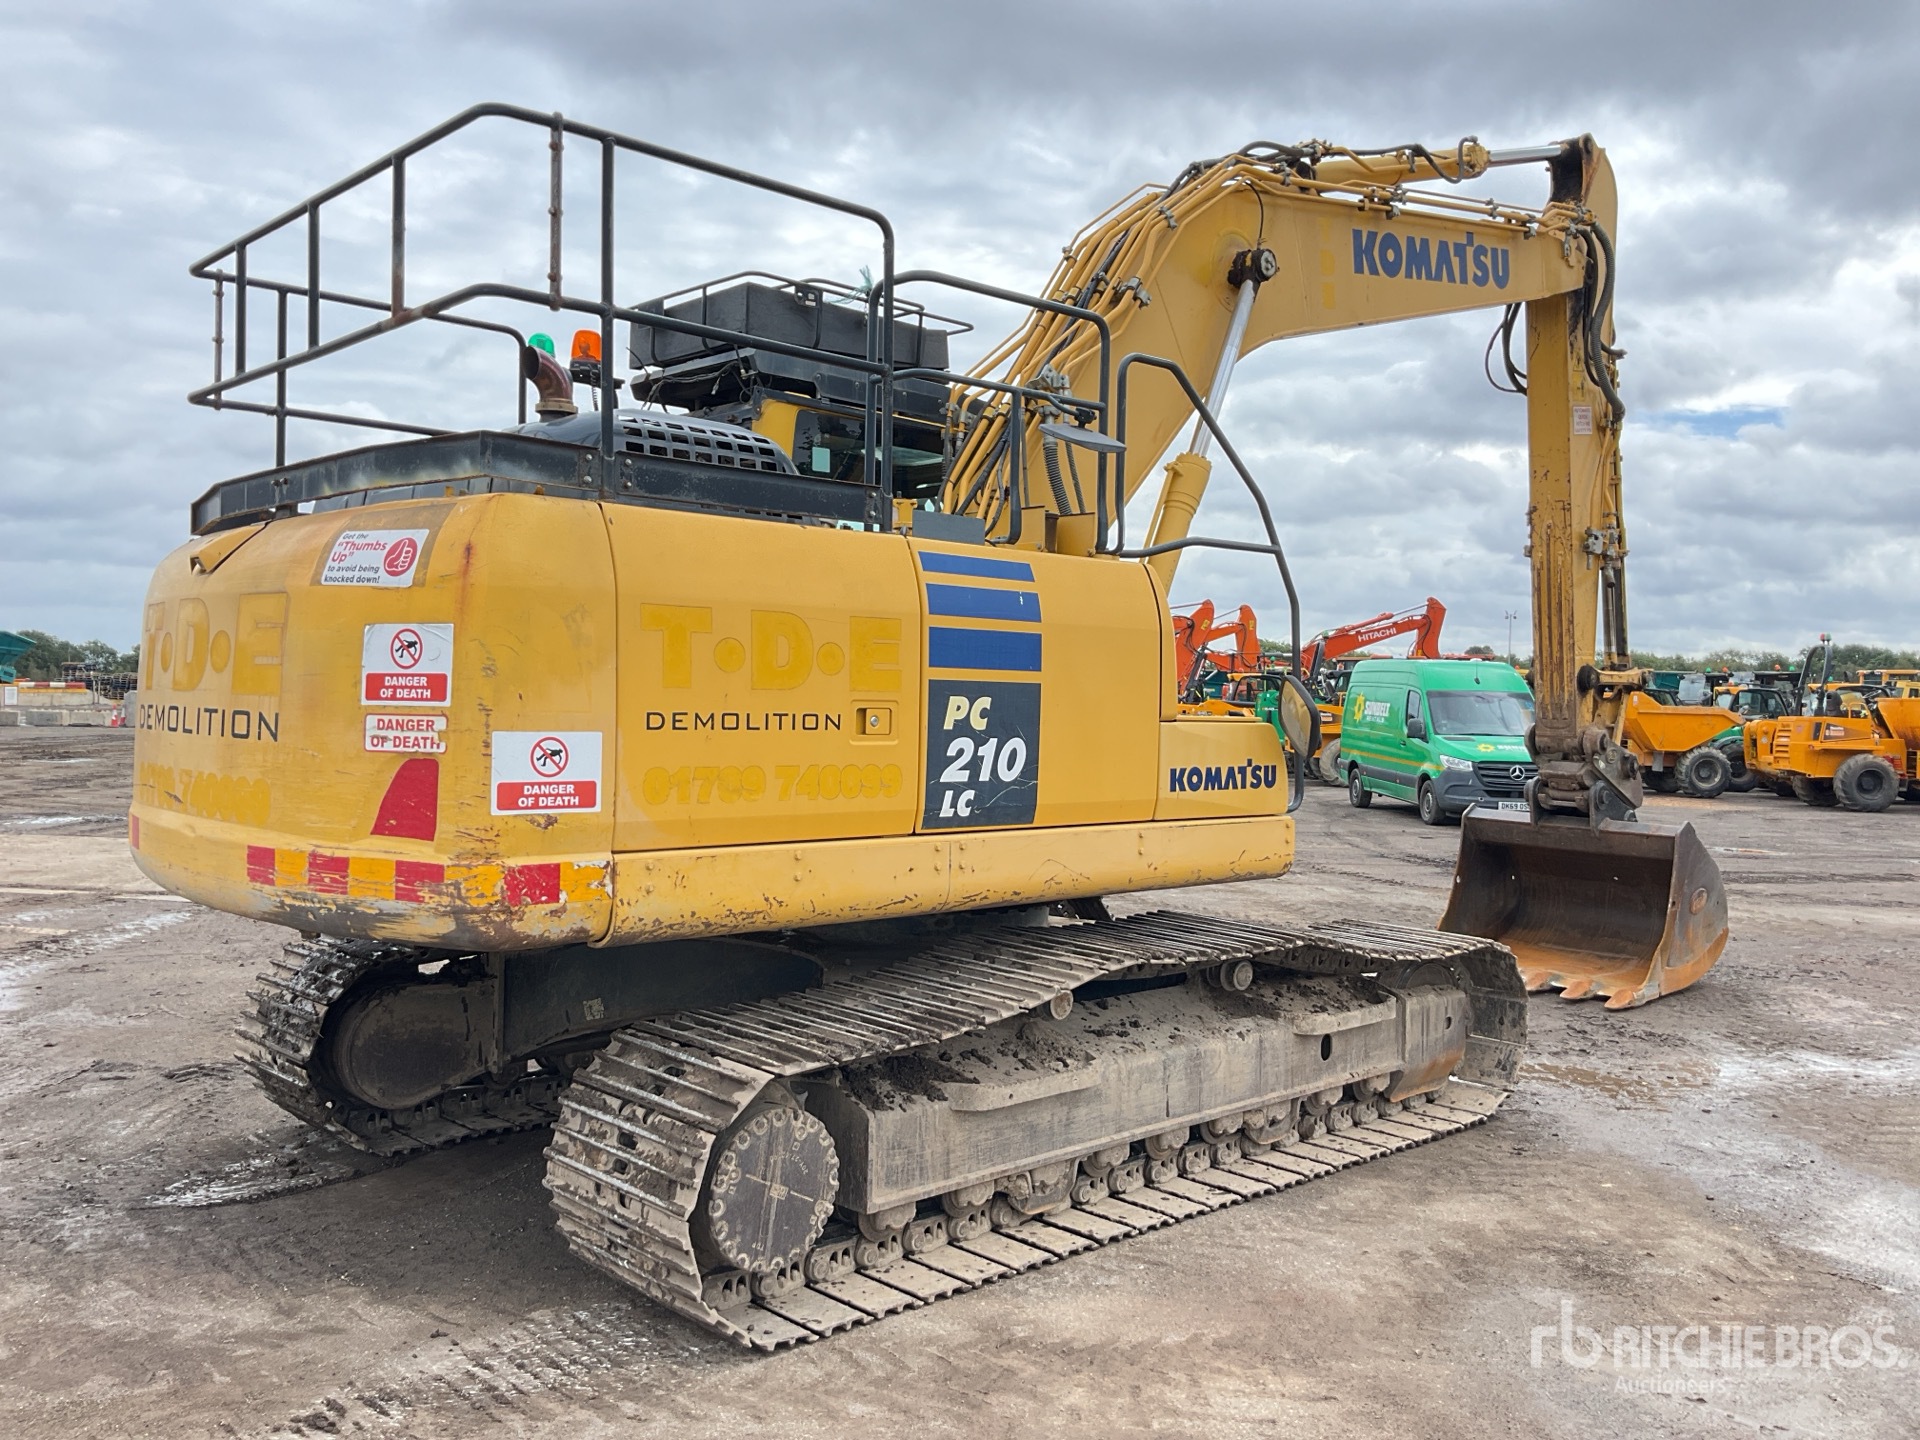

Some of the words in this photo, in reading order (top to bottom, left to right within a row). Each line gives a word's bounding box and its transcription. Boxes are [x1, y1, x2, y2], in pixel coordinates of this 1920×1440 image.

[1352, 229, 1510, 290] KOMATSU
[336, 565, 356, 573] avoid
[358, 565, 380, 574] being
[356, 576, 380, 584] down!
[1358, 627, 1397, 643] HITACHI
[384, 676, 428, 687] DANGER
[380, 689, 393, 699] OF
[396, 689, 431, 699] DEATH
[646, 711, 842, 731] DEMOLITION
[943, 696, 992, 731] PC
[139, 704, 279, 742] DEMOLITION
[376, 718, 435, 732] DANGER
[370, 735, 389, 748] OF
[392, 735, 441, 750] DEATH
[939, 737, 1027, 782] 210
[1169, 758, 1277, 793] KOMATSU
[523, 784, 575, 795] DANGER
[518, 797, 535, 807] OF
[538, 796, 579, 806] DEATH
[939, 789, 975, 818] LC
[1501, 802, 1518, 810] DK69
